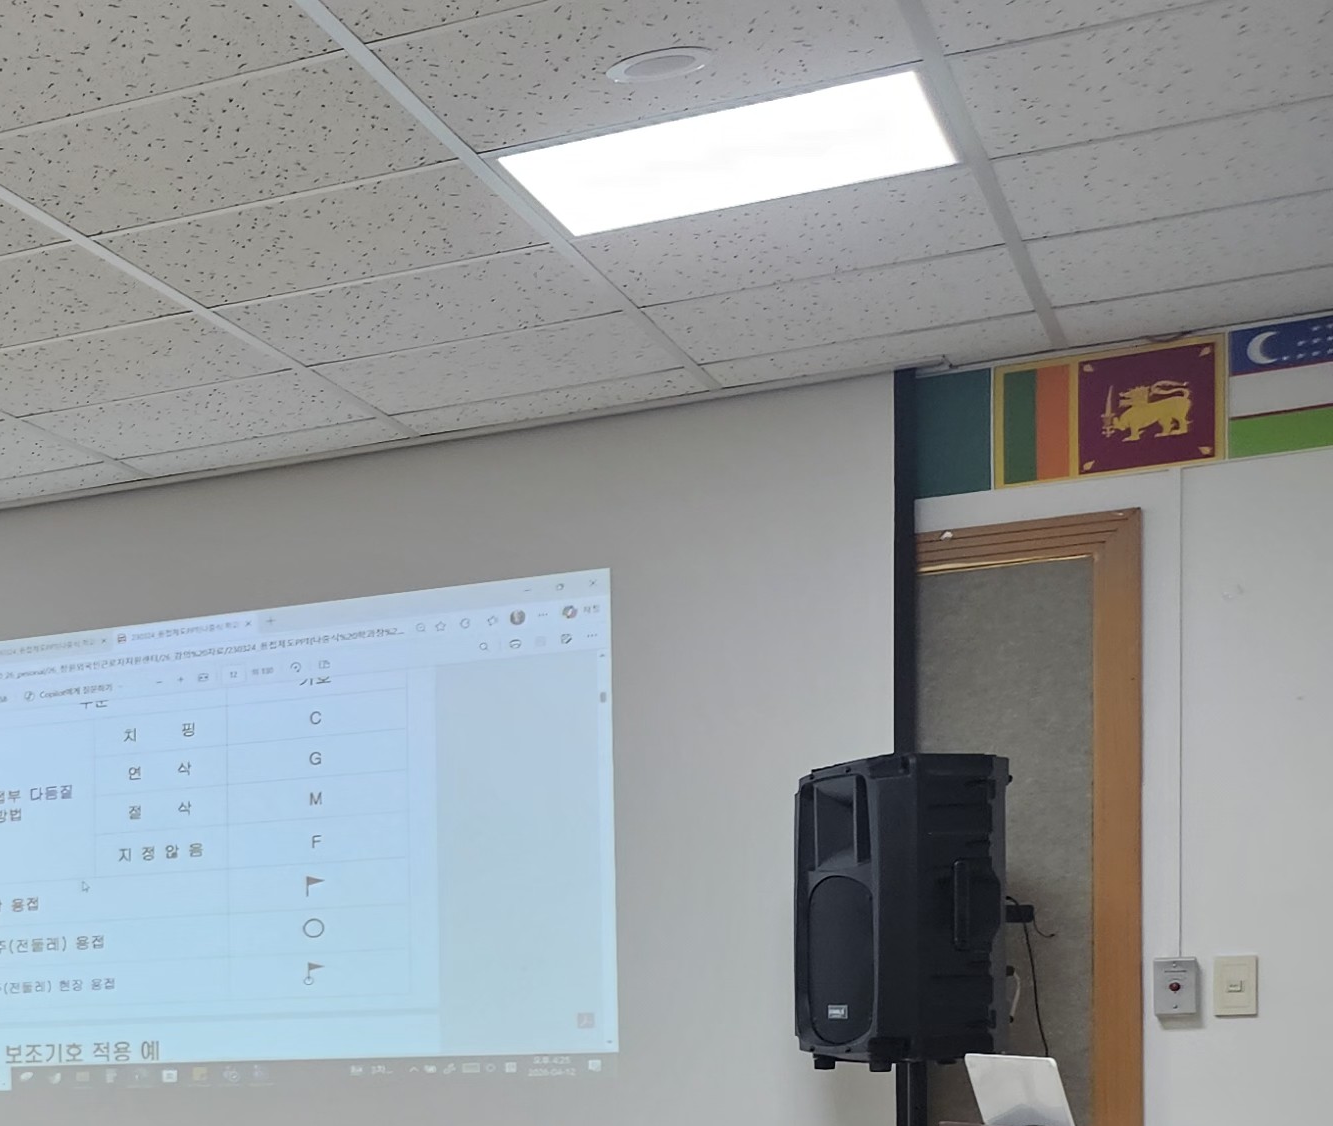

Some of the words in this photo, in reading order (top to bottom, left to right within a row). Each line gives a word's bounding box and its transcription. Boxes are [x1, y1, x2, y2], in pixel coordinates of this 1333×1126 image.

[309, 710, 322, 726] C
[309, 751, 323, 766] G
[128, 765, 142, 782] 연
[177, 760, 192, 777] 삭
[309, 792, 323, 806] M
[128, 804, 142, 820] 절
[177, 800, 192, 816] 삭
[311, 834, 322, 849] F
[11, 896, 39, 913] 용접
[75, 934, 105, 950] 용접
[59, 979, 83, 992] 현장
[91, 977, 116, 991] 용접
[5, 1042, 84, 1065] 보조기호
[92, 1041, 132, 1063] 적용
[140, 1039, 160, 1061] 예
